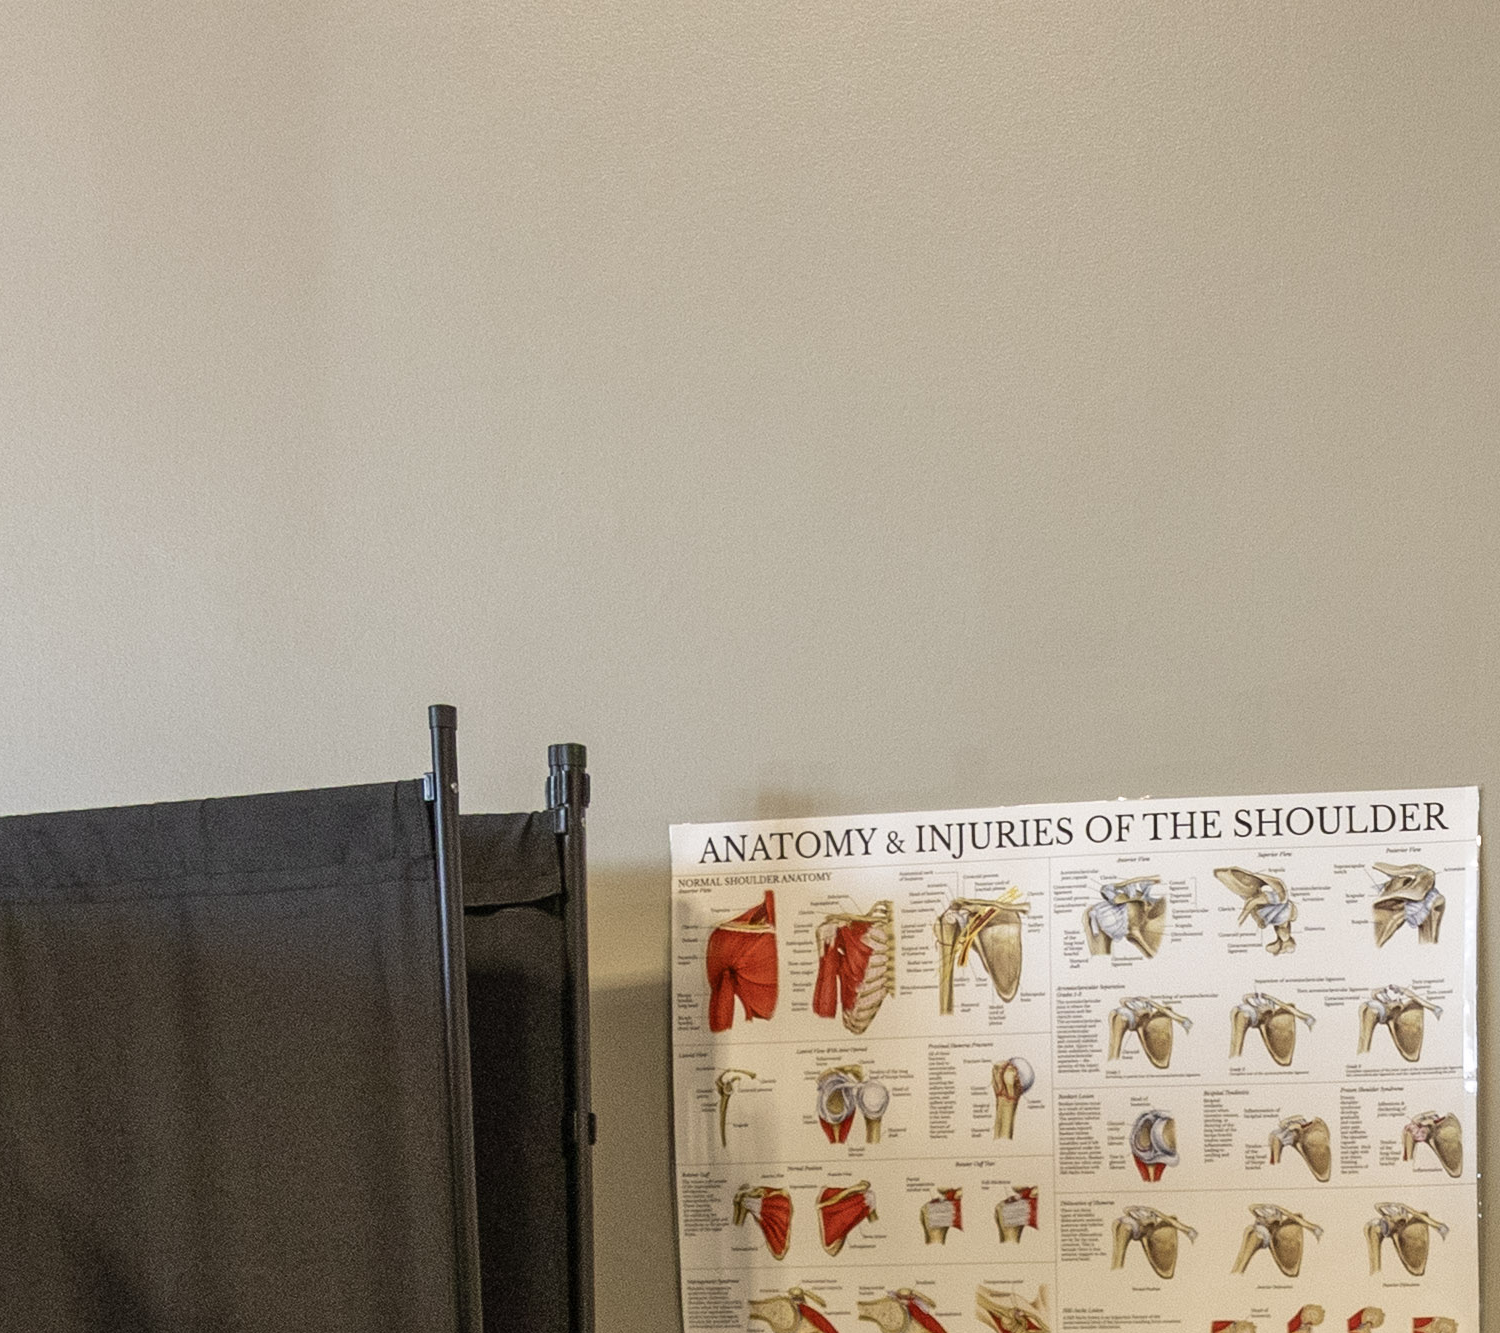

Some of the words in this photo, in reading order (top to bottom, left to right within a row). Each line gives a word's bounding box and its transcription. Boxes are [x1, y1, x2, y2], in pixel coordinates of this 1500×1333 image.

[699, 828, 878, 864] ANATOMY
[886, 831, 906, 855] &
[915, 817, 1074, 859] INJURIES
[1086, 814, 1134, 843] OF
[1143, 810, 1222, 841] THE
[1233, 802, 1449, 838] SHOULDER
[678, 878, 722, 888] NORMAL
[725, 875, 779, 885] SHOULDER
[782, 872, 832, 883] ANATOMY
